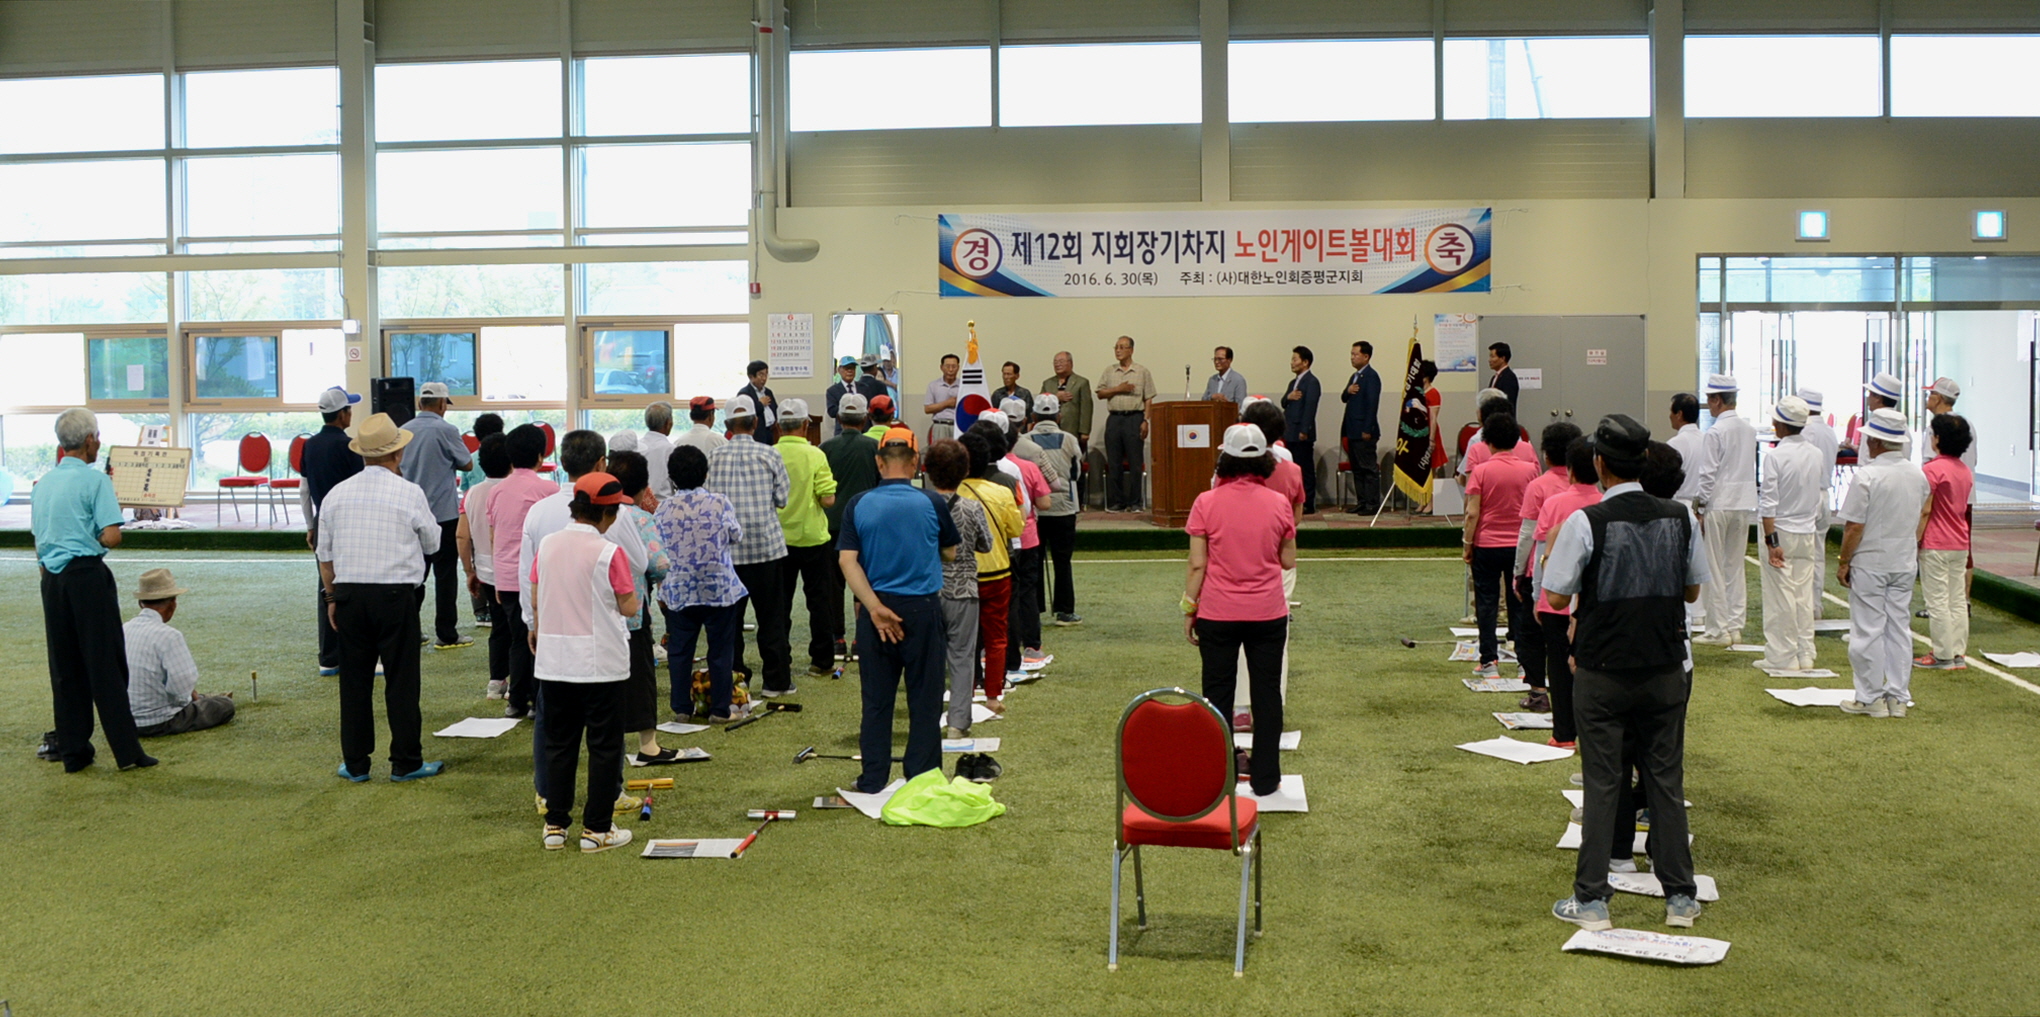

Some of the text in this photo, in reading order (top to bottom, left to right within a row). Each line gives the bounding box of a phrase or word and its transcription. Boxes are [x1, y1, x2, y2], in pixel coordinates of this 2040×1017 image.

[963, 237, 990, 271] 경
[1011, 227, 1416, 265] 제12회 지회장기차지 노인게이트볼대회
[1435, 232, 1466, 266] 축
[1064, 273, 1101, 286] 2016.
[1105, 274, 1117, 286] 6.
[1121, 271, 1158, 286] 30(목)
[1180, 271, 1205, 285] 주최
[1216, 269, 1364, 285] (사)대한노인회증평군지회
